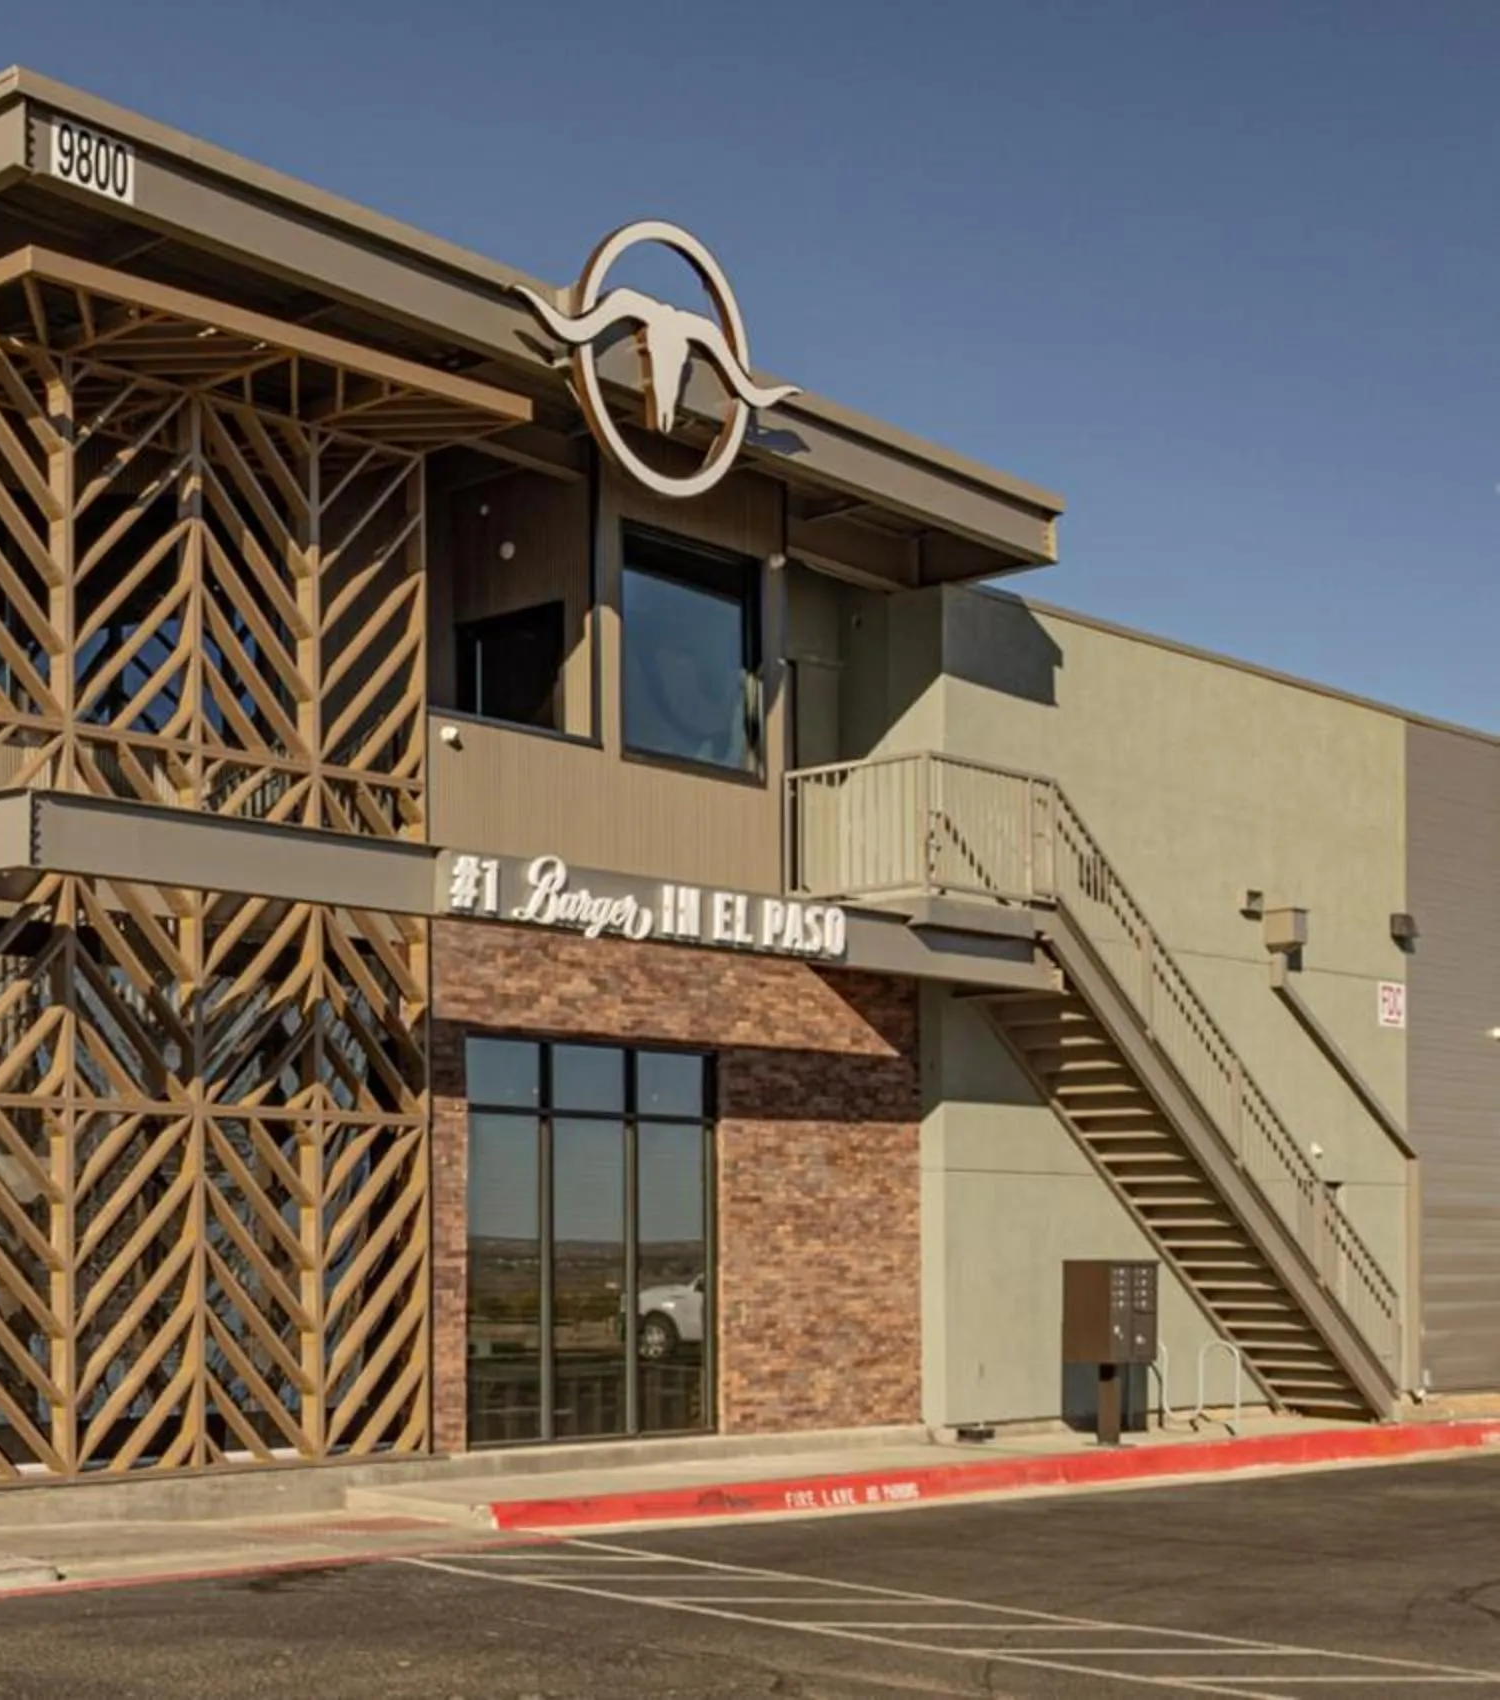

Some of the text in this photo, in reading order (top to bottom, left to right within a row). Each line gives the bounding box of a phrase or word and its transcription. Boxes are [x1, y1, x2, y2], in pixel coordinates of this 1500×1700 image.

[58, 123, 128, 197] 9800
[450, 854, 848, 957] #1 Burger IN EL PASO
